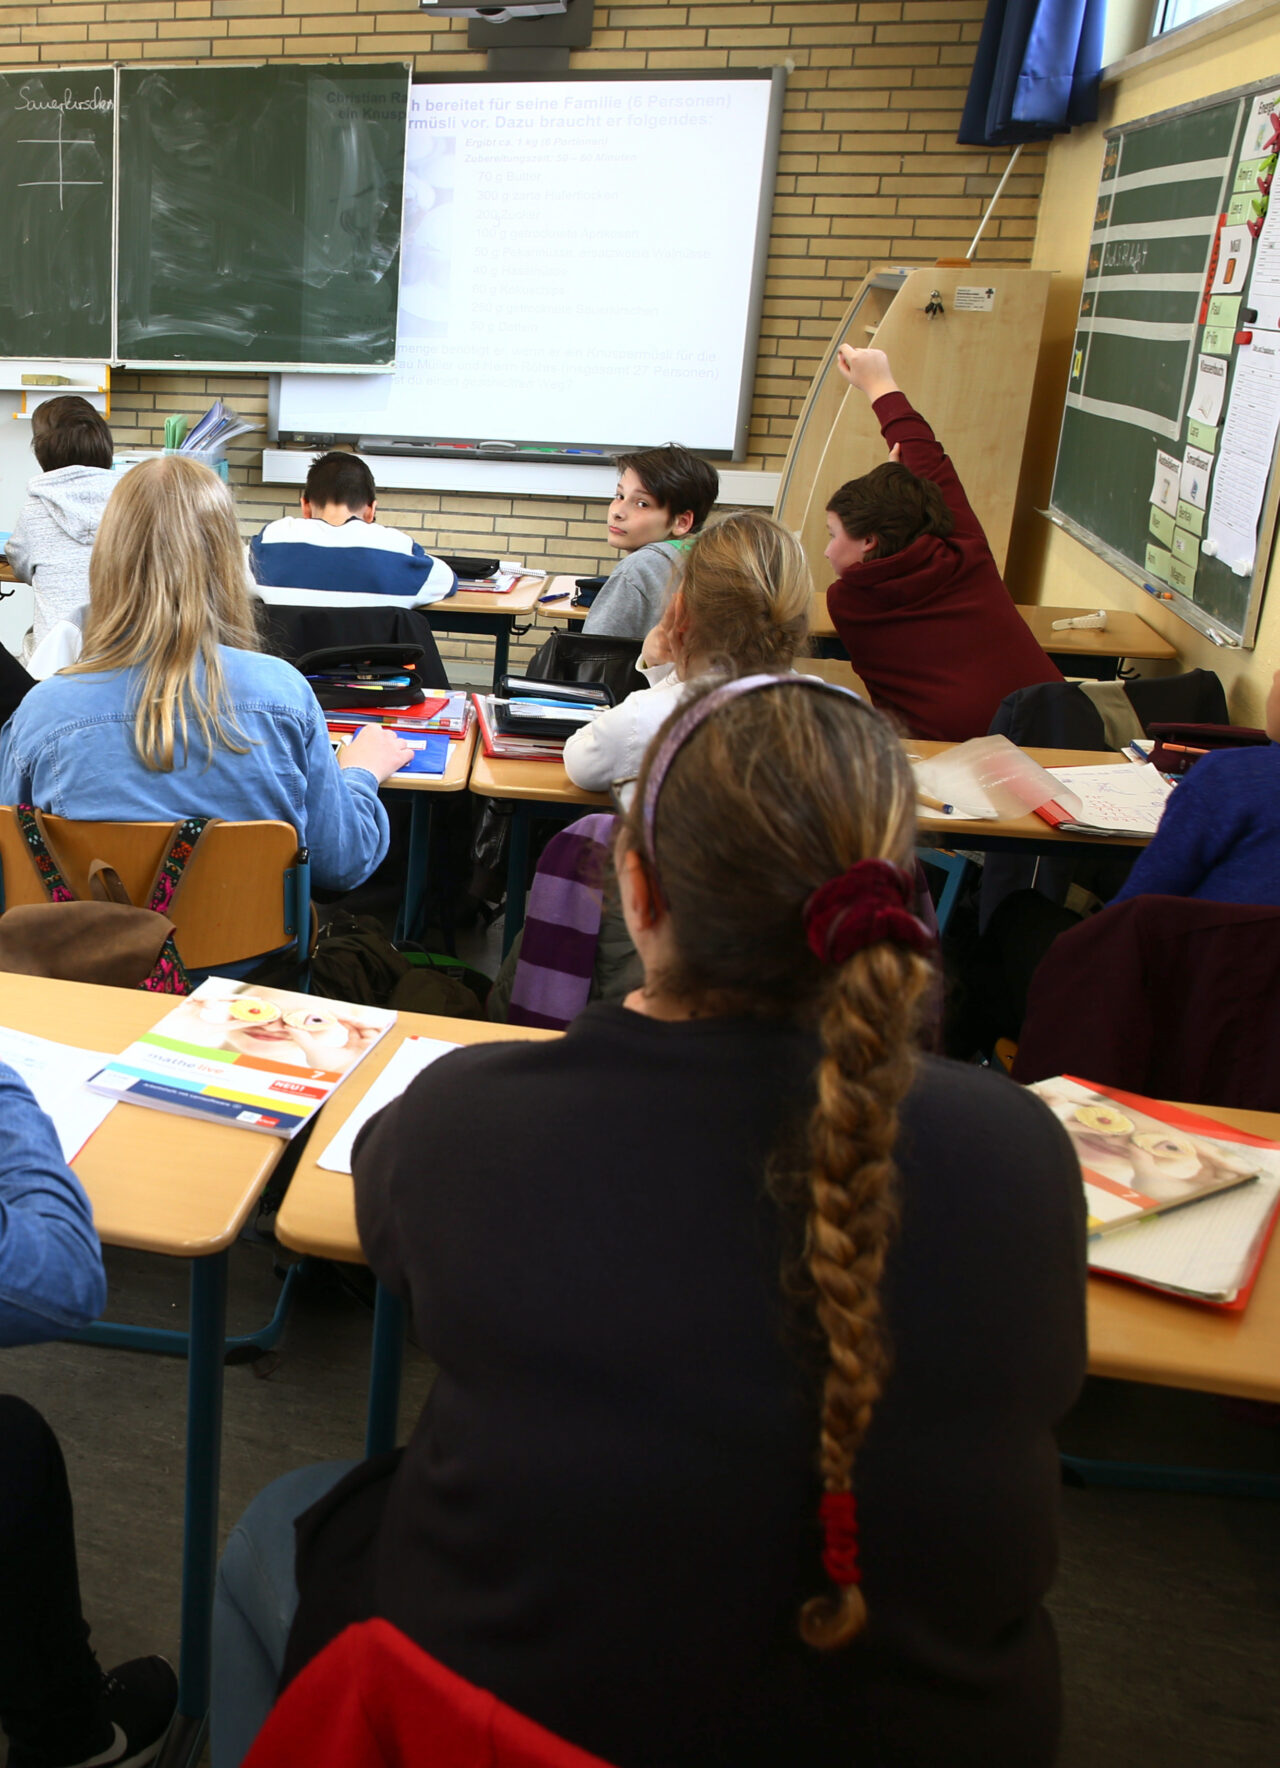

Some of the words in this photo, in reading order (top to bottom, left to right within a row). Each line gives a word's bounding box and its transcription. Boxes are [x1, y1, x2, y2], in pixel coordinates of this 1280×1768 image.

[425, 99, 484, 112] bereitet
[489, 98, 511, 112] für
[516, 98, 559, 111] seine
[564, 96, 623, 110] Familie
[647, 94, 733, 109] Personen)
[461, 117, 489, 129] vor.
[495, 115, 534, 129] Dazu
[539, 113, 602, 128] braucht
[606, 114, 623, 128] er
[627, 112, 713, 130] folgendes:
[147, 1051, 196, 1069] mathe
[197, 1062, 225, 1076] live
[310, 1070, 326, 1080] 7
[274, 1080, 306, 1092] NEU!
